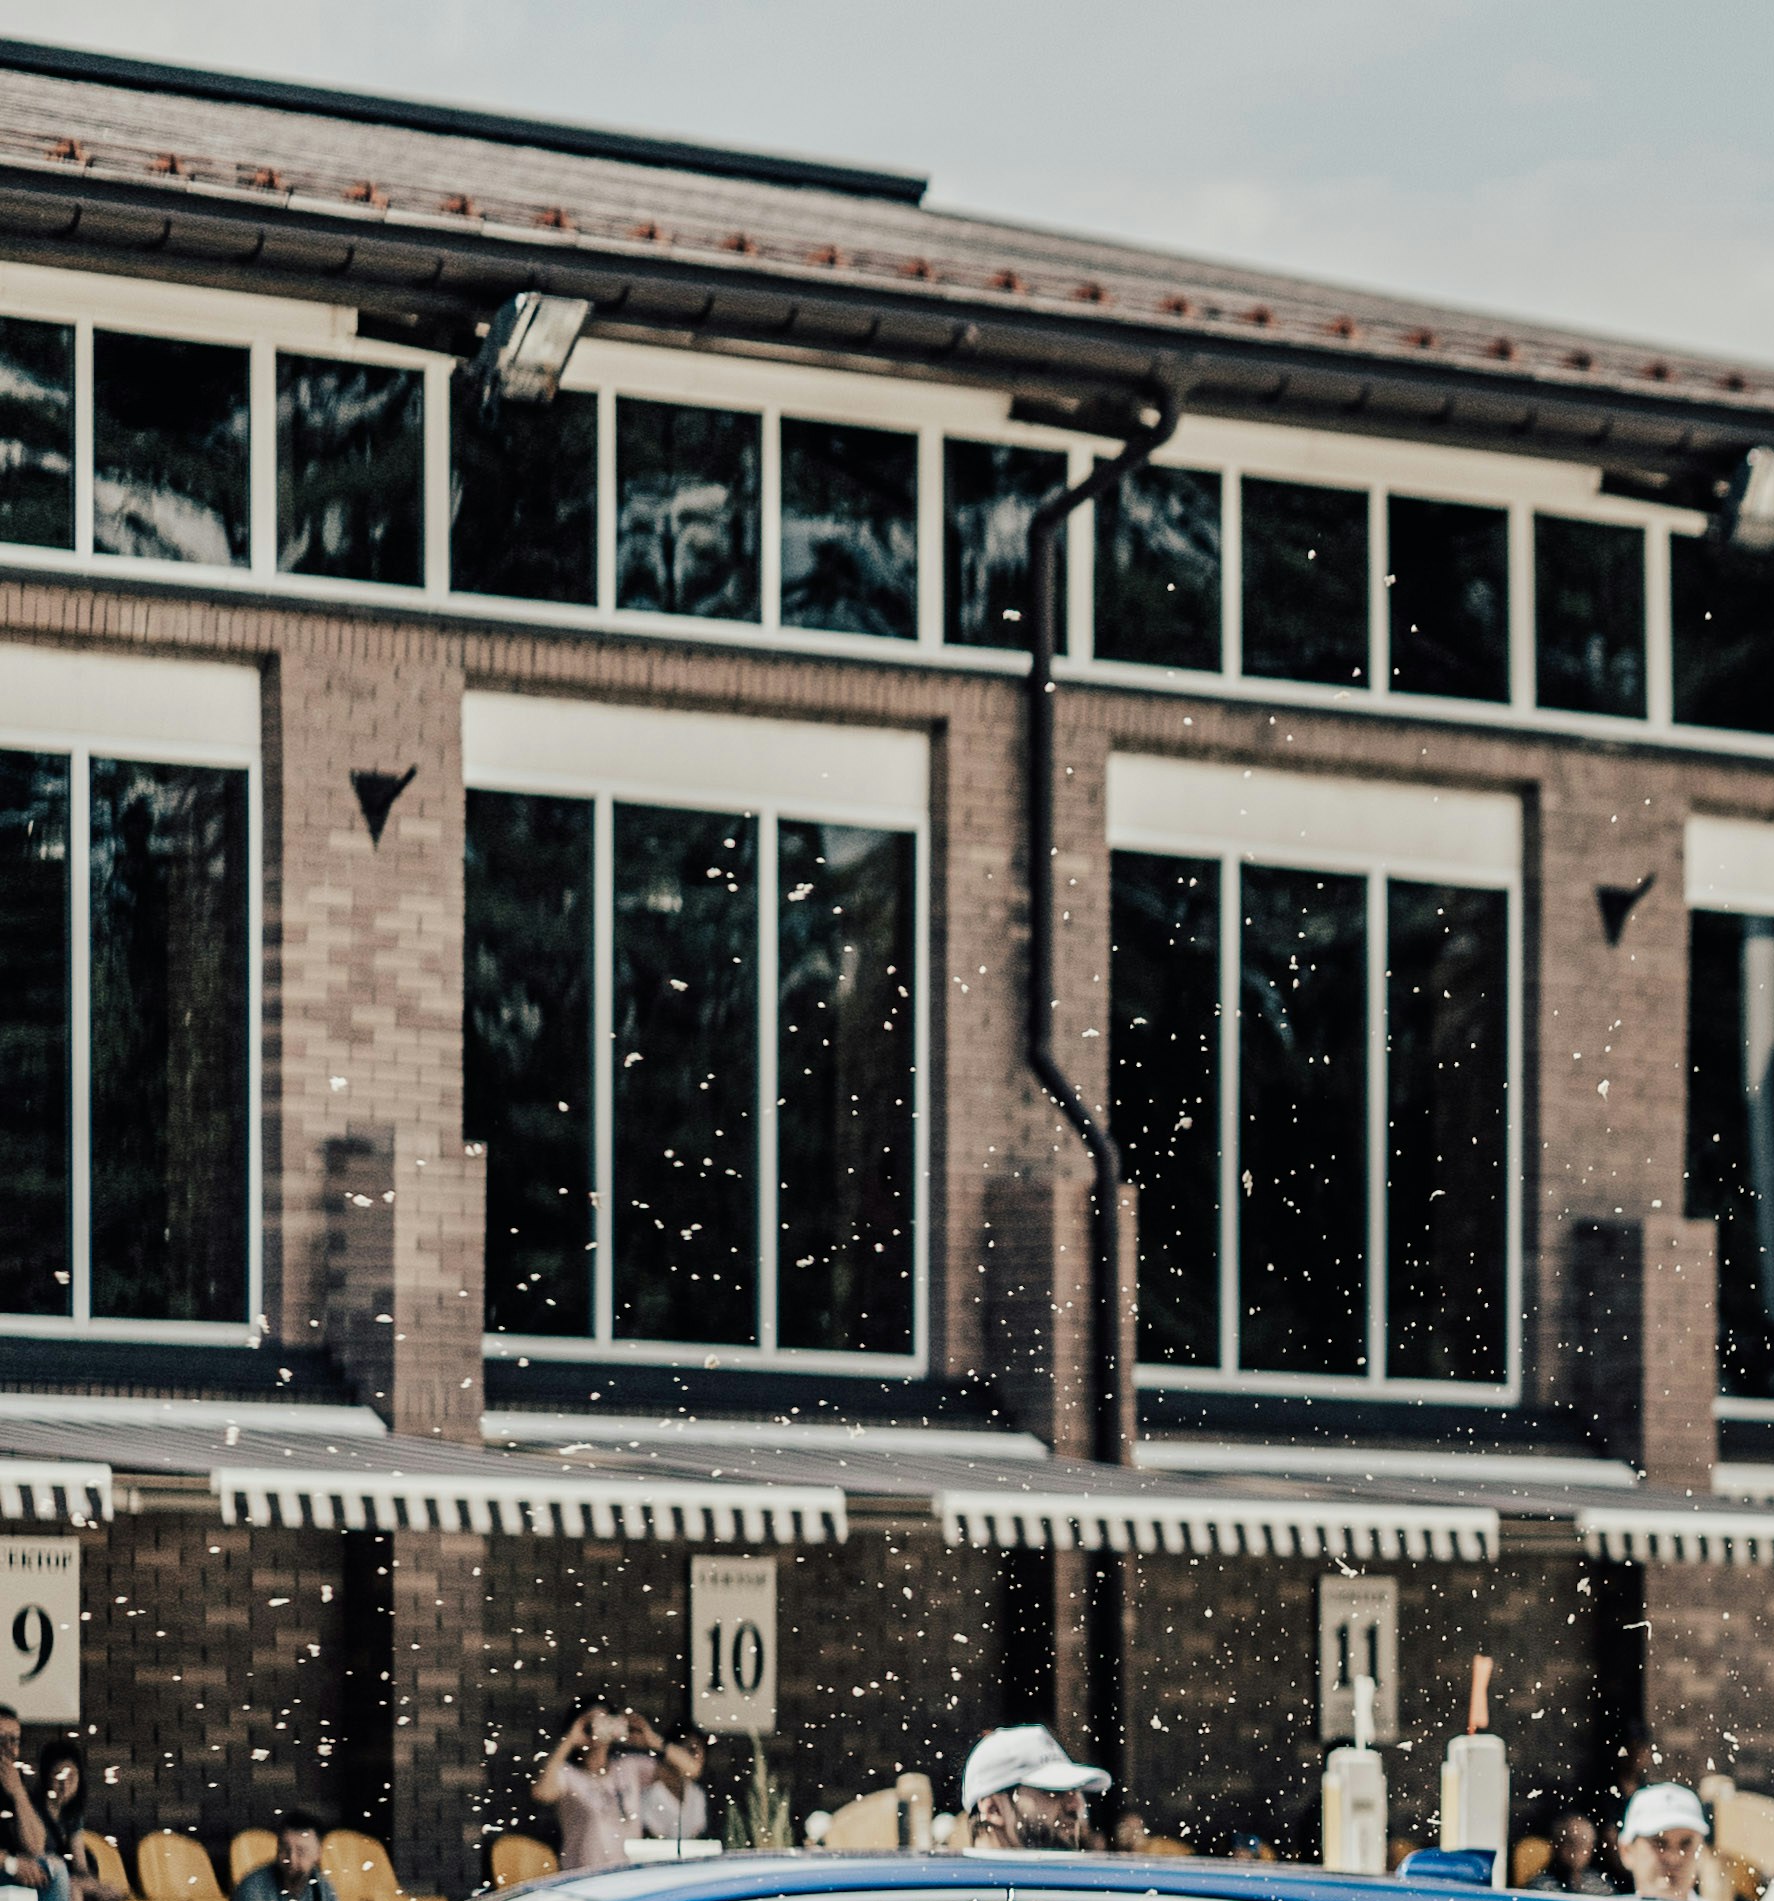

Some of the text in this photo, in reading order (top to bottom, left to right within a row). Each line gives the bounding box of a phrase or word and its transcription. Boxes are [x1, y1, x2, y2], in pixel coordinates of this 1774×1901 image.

[12, 1604, 54, 1685] 9
[707, 1619, 764, 1697] 10
[1335, 1619, 1382, 1691] 11
